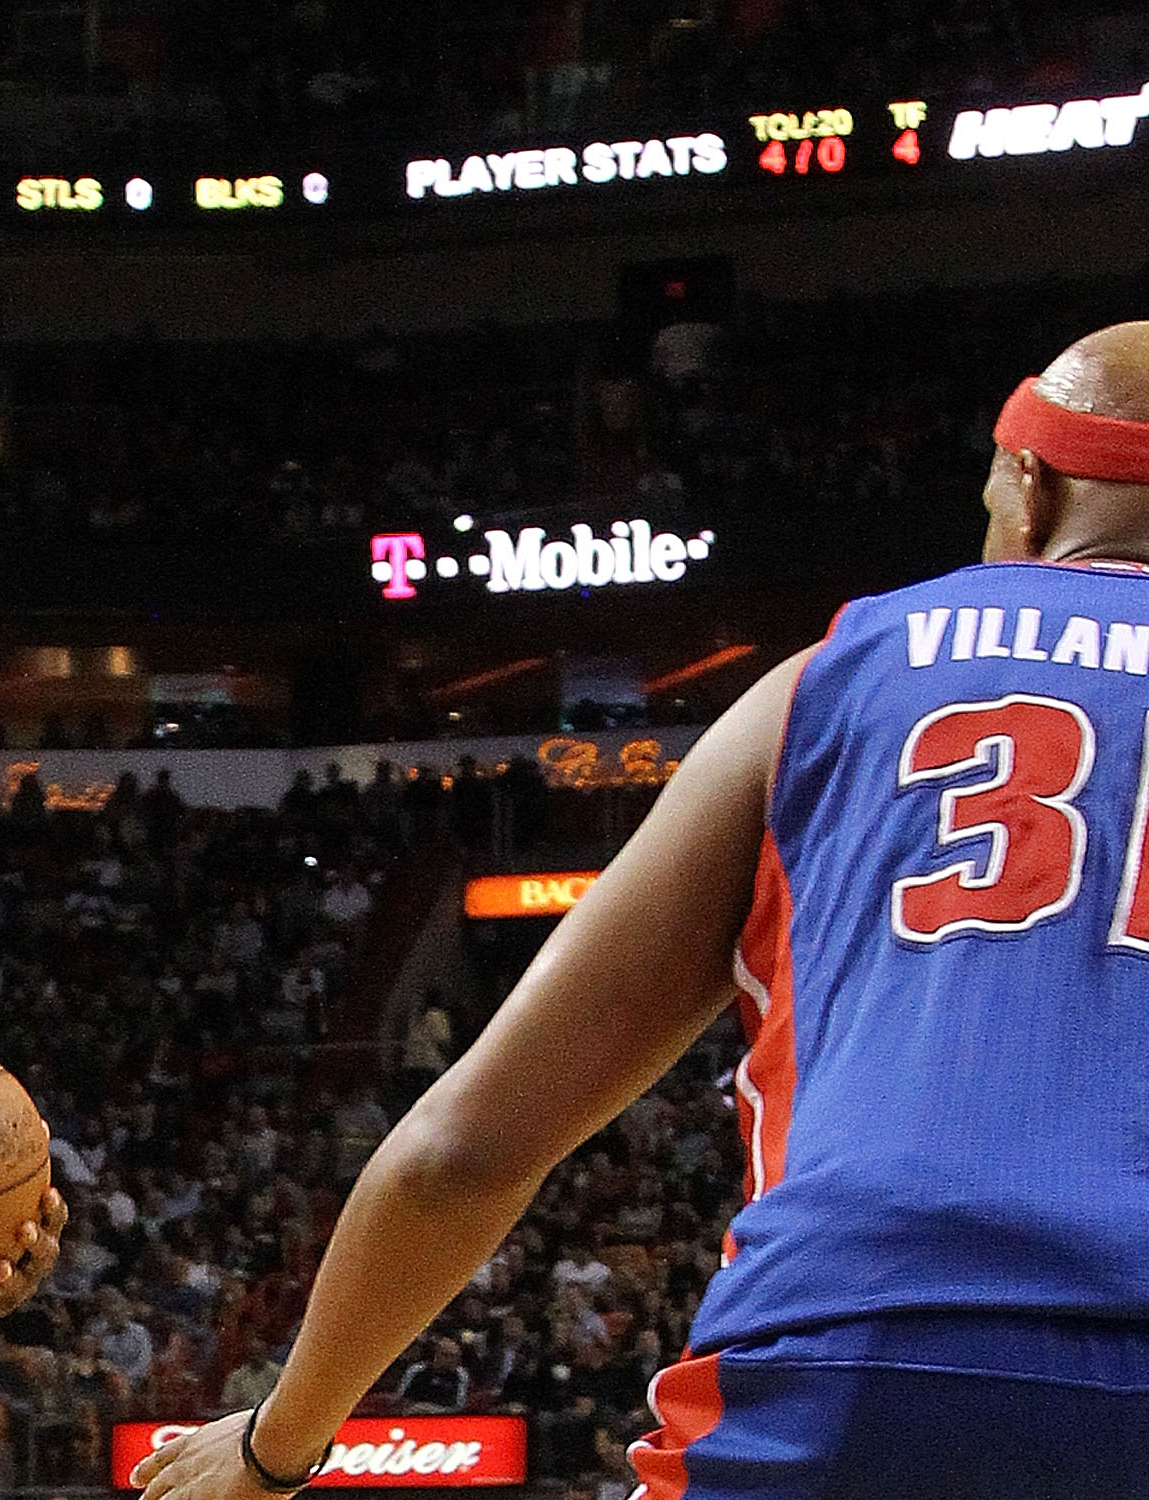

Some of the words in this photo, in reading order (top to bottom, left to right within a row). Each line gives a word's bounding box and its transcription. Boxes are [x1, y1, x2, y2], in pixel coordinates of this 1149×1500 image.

[887, 100, 928, 130] TF
[948, 82, 1149, 160] HEAT
[405, 154, 579, 199] PLAYER
[582, 132, 728, 184] STATS
[891, 129, 922, 165] 4
[16, 177, 104, 211] STLS
[124, 177, 152, 211] 0
[195, 175, 284, 209] BLKS
[302, 172, 329, 204] 0
[906, 605, 1149, 677] VILLAN
